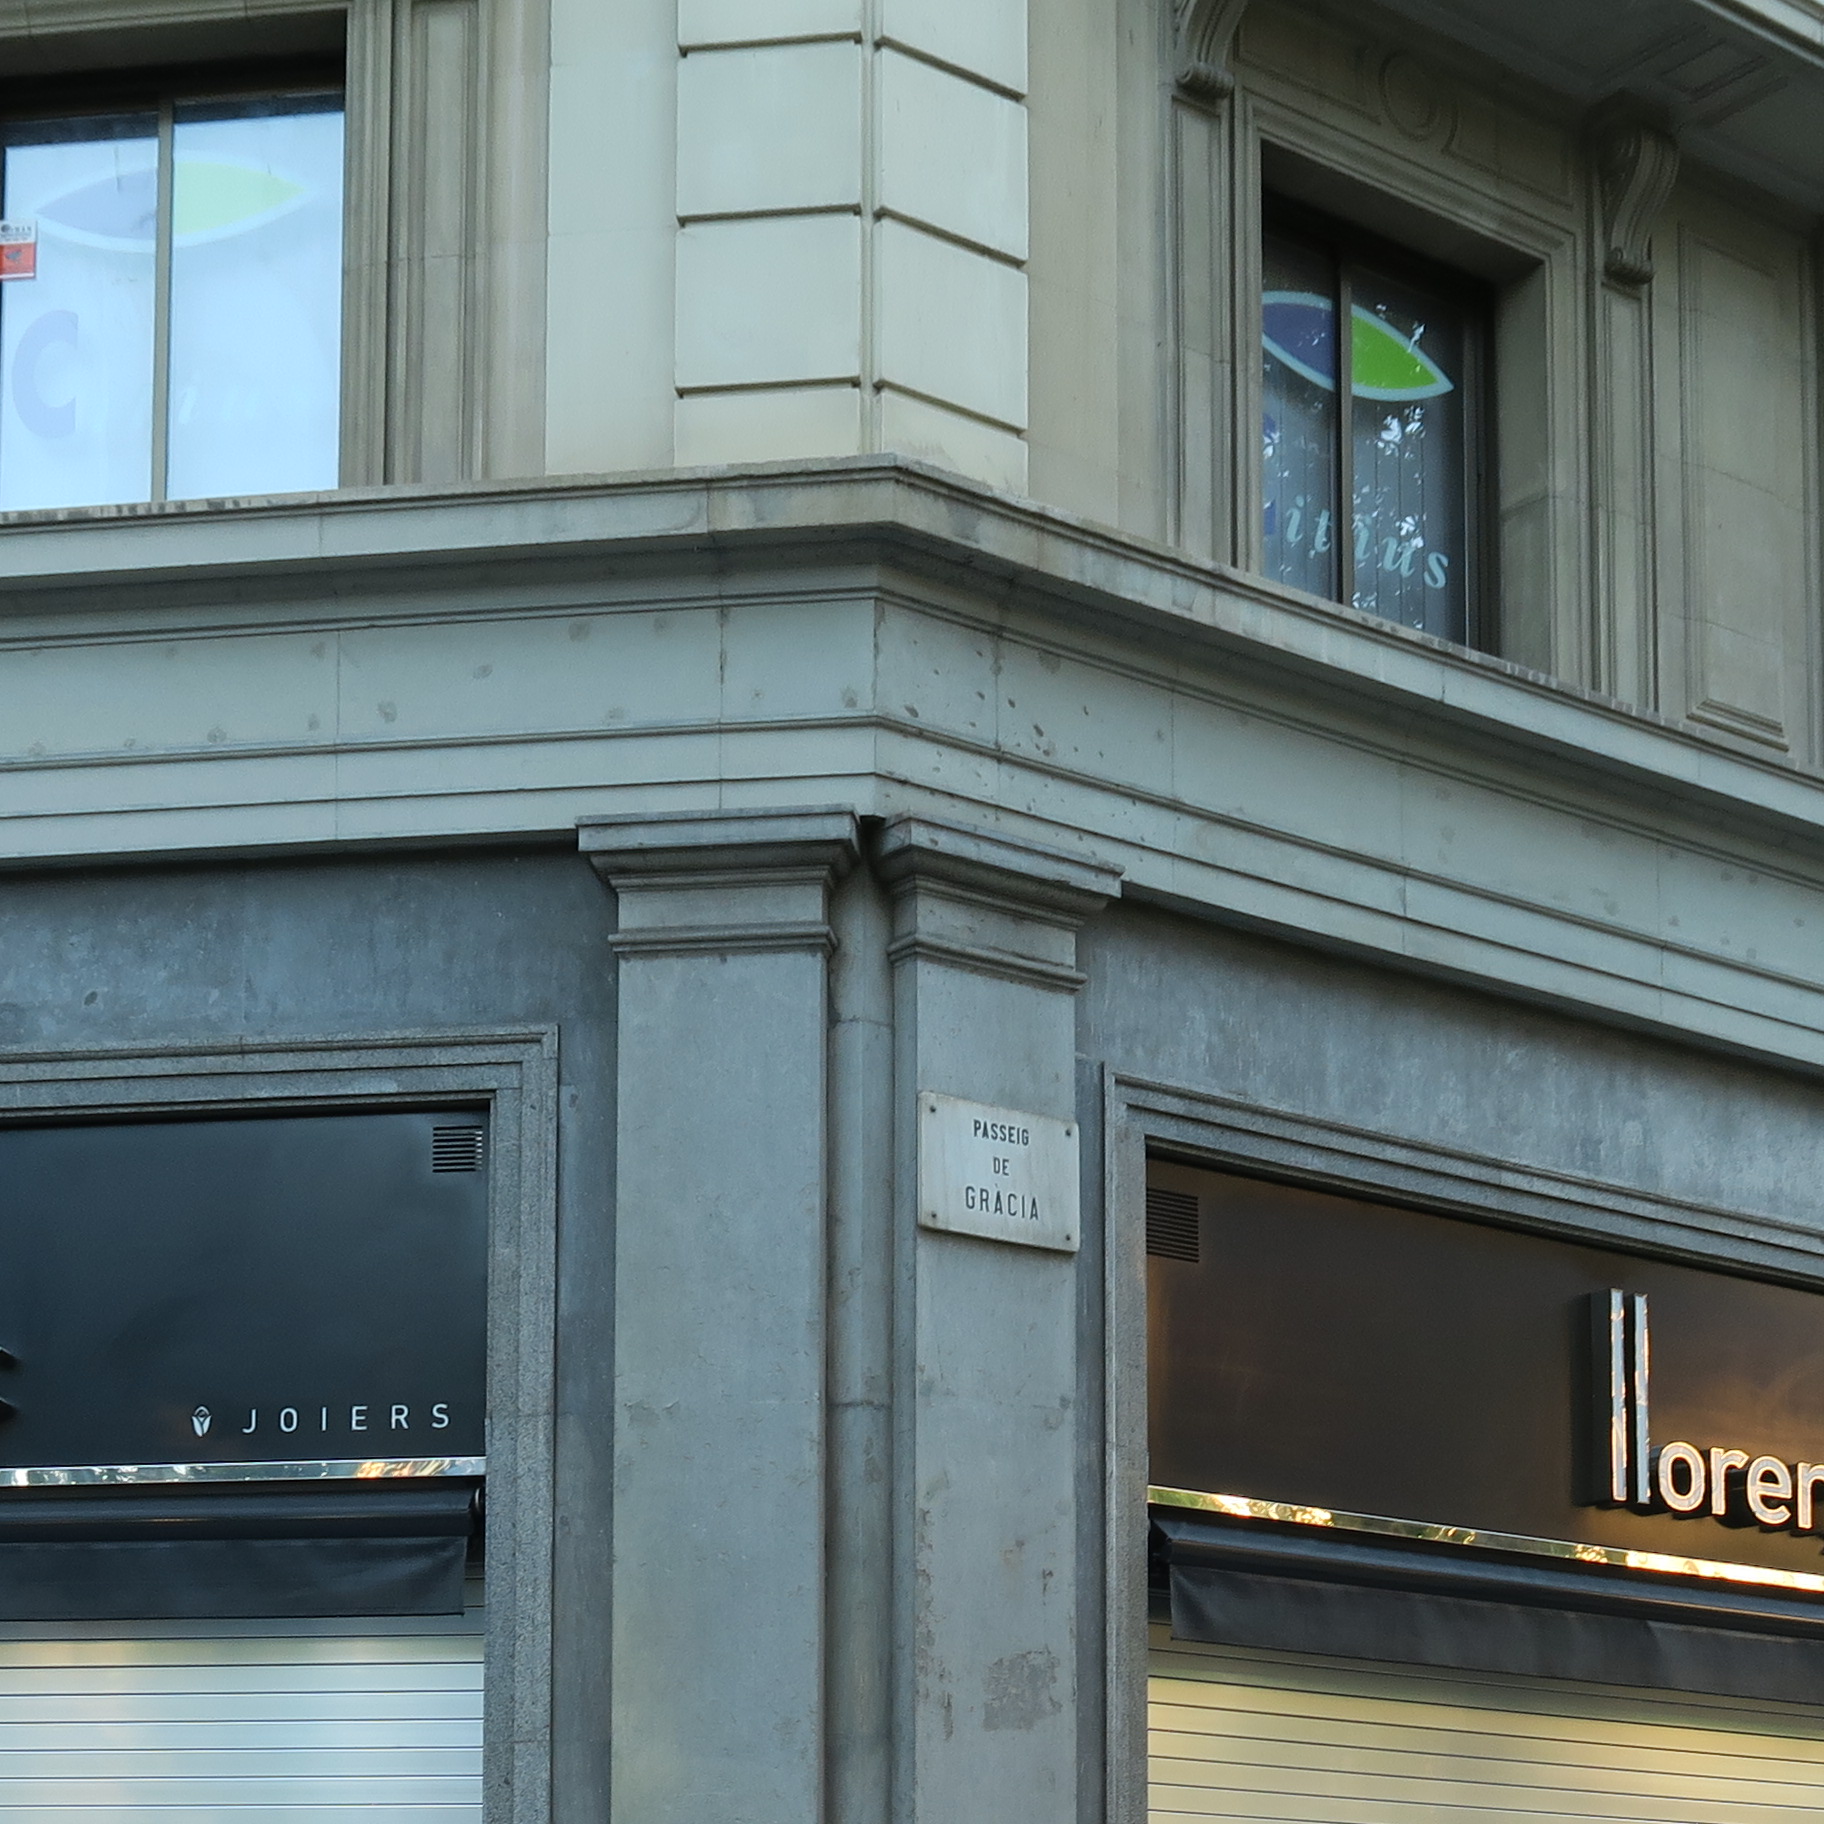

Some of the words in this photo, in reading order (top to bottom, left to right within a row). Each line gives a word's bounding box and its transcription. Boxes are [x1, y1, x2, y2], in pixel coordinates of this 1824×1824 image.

[973, 1119, 1030, 1146] PASSEIG
[992, 1156, 1010, 1176] DE
[965, 1183, 1039, 1221] GRÀCIA
[241, 1403, 451, 1434] JOIERS
